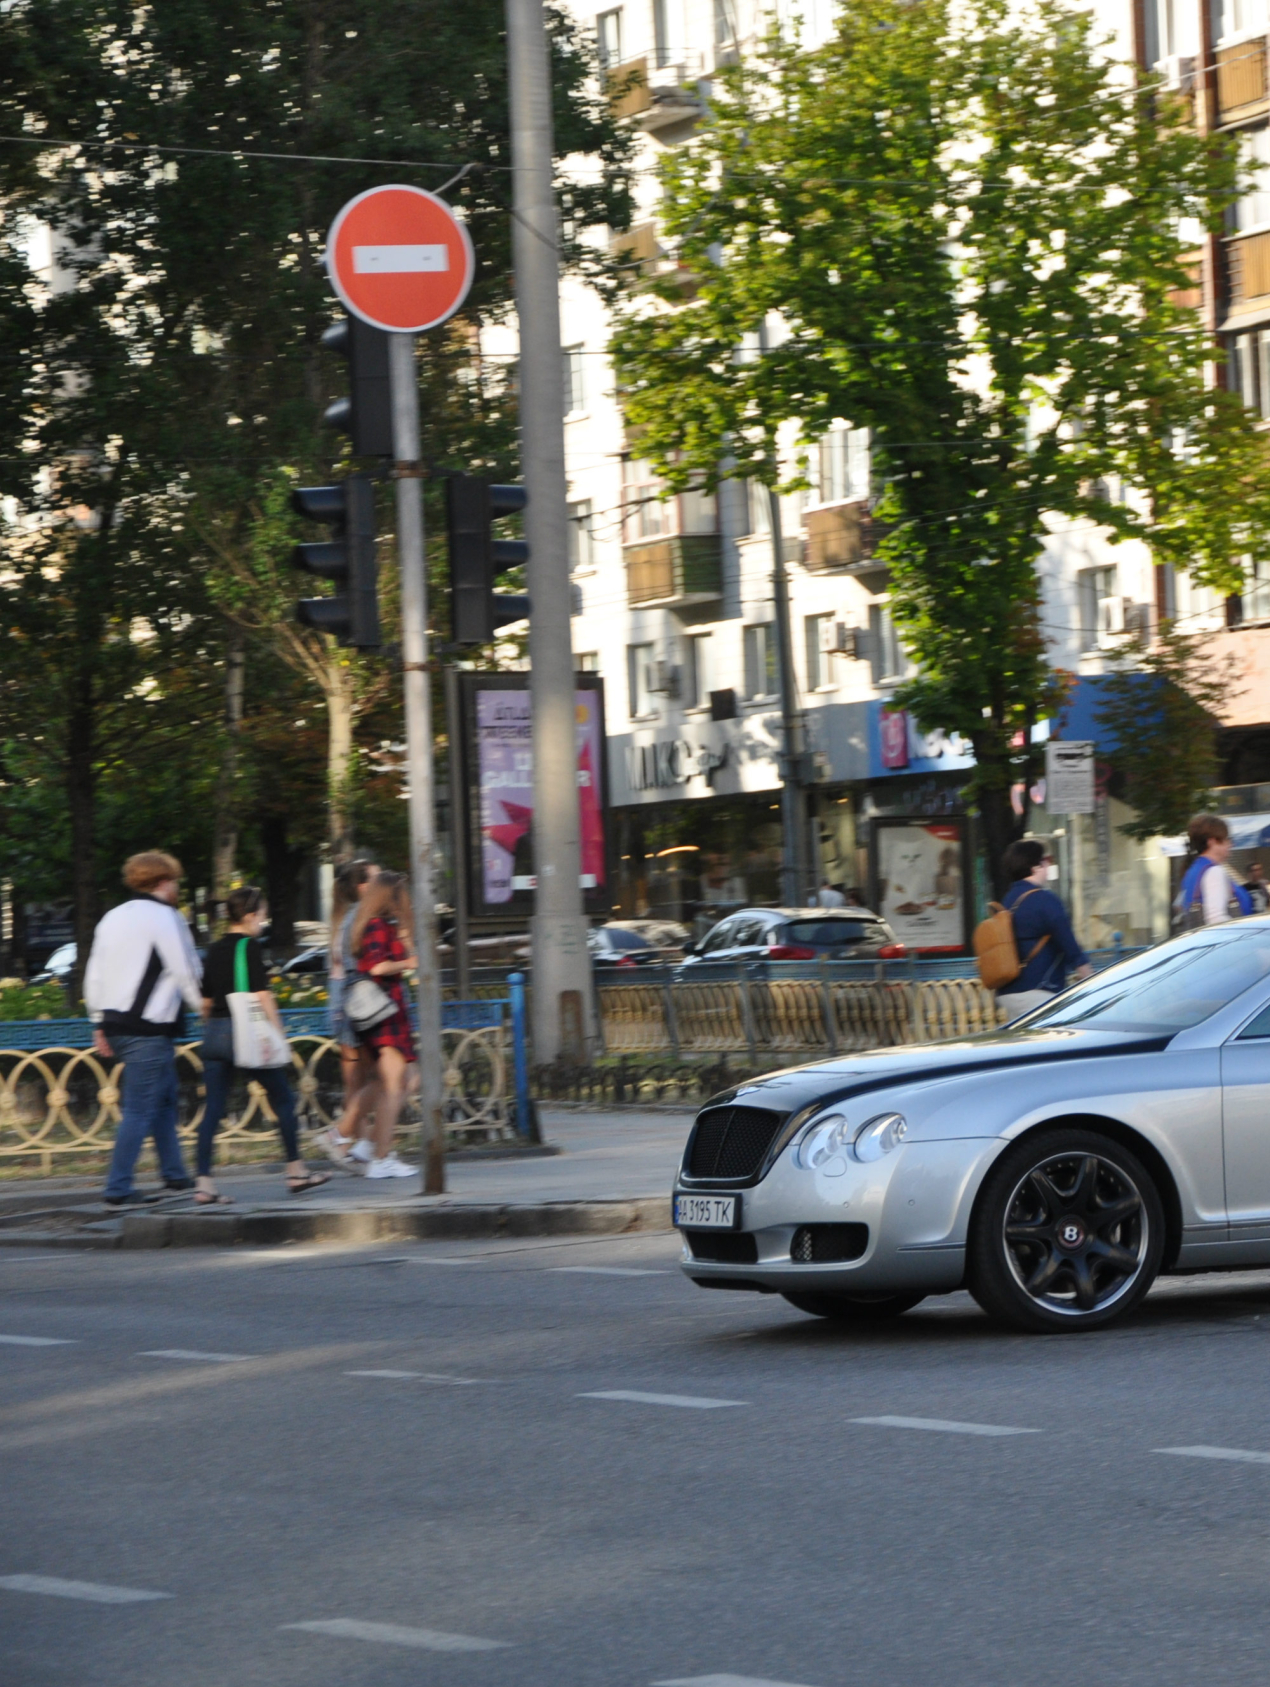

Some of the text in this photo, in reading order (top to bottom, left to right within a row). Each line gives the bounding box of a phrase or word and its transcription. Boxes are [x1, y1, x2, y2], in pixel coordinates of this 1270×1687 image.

[689, 1199, 711, 1222] 3195
[714, 1200, 731, 1223] TK
[1063, 1226, 1078, 1241] B
